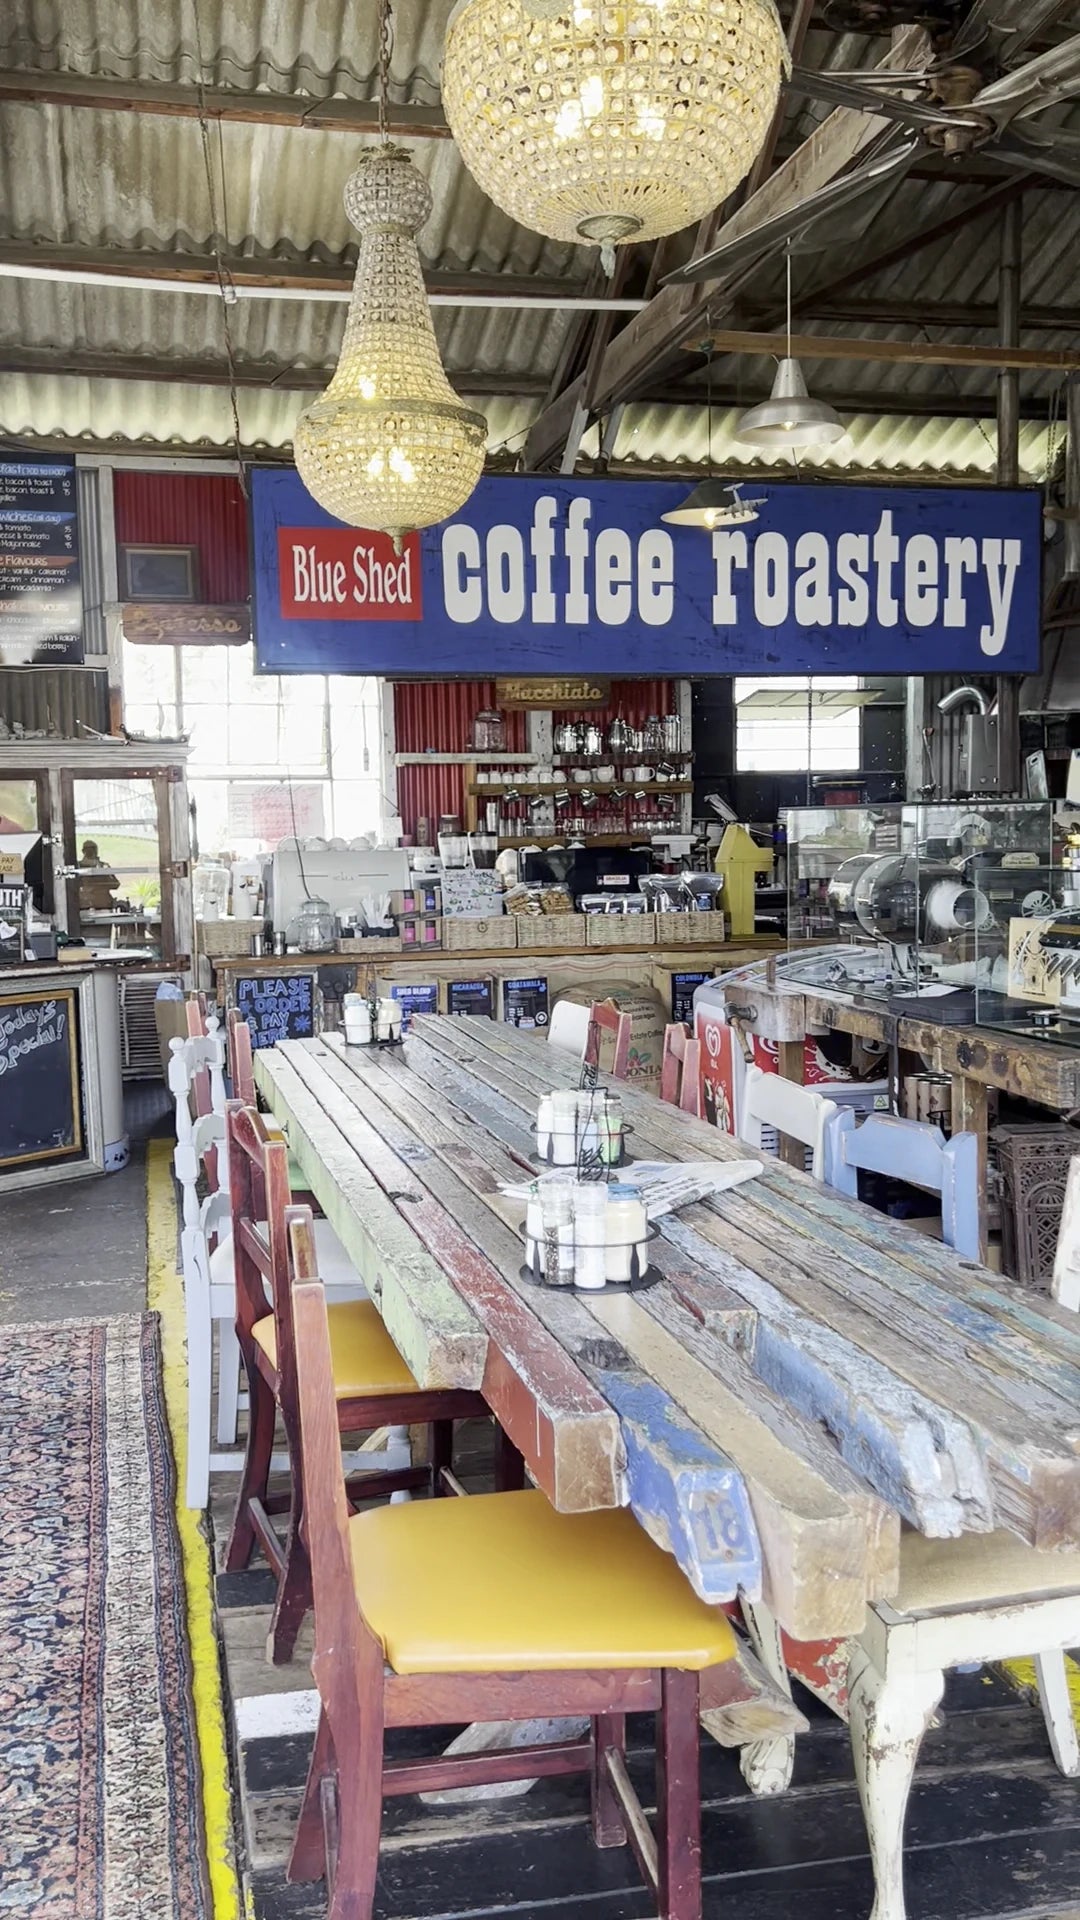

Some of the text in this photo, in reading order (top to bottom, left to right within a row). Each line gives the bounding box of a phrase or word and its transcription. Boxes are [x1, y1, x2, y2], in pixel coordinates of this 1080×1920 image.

[5, 478, 26, 486] bacon
[30, 576, 65, 584] cinnamon
[38, 568, 67, 576] caramel
[292, 545, 412, 604] Blue Shed
[442, 496, 1021, 656] coffee roastery
[11, 584, 52, 592] macadamia
[506, 682, 603, 700] Macchiato
[239, 977, 311, 999] PLEASE
[254, 995, 311, 1013] ORDER
[262, 1012, 289, 1030] PAY
